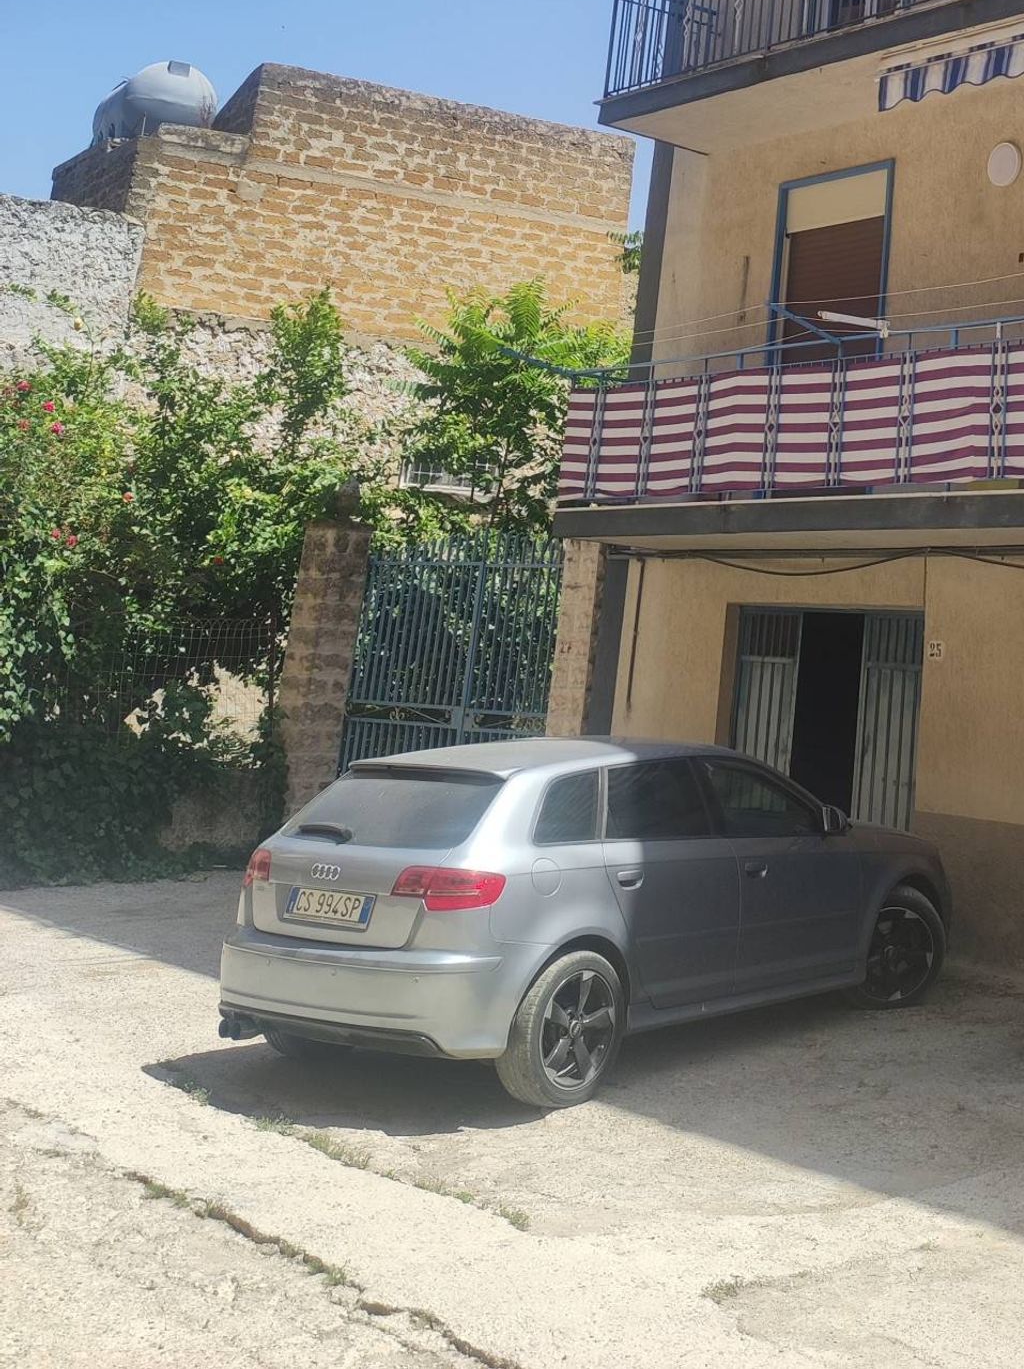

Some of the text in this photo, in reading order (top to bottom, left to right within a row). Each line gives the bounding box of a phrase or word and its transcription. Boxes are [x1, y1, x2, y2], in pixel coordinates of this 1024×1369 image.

[929, 641, 942, 658] 25
[296, 891, 361, 918] CS 994SP
